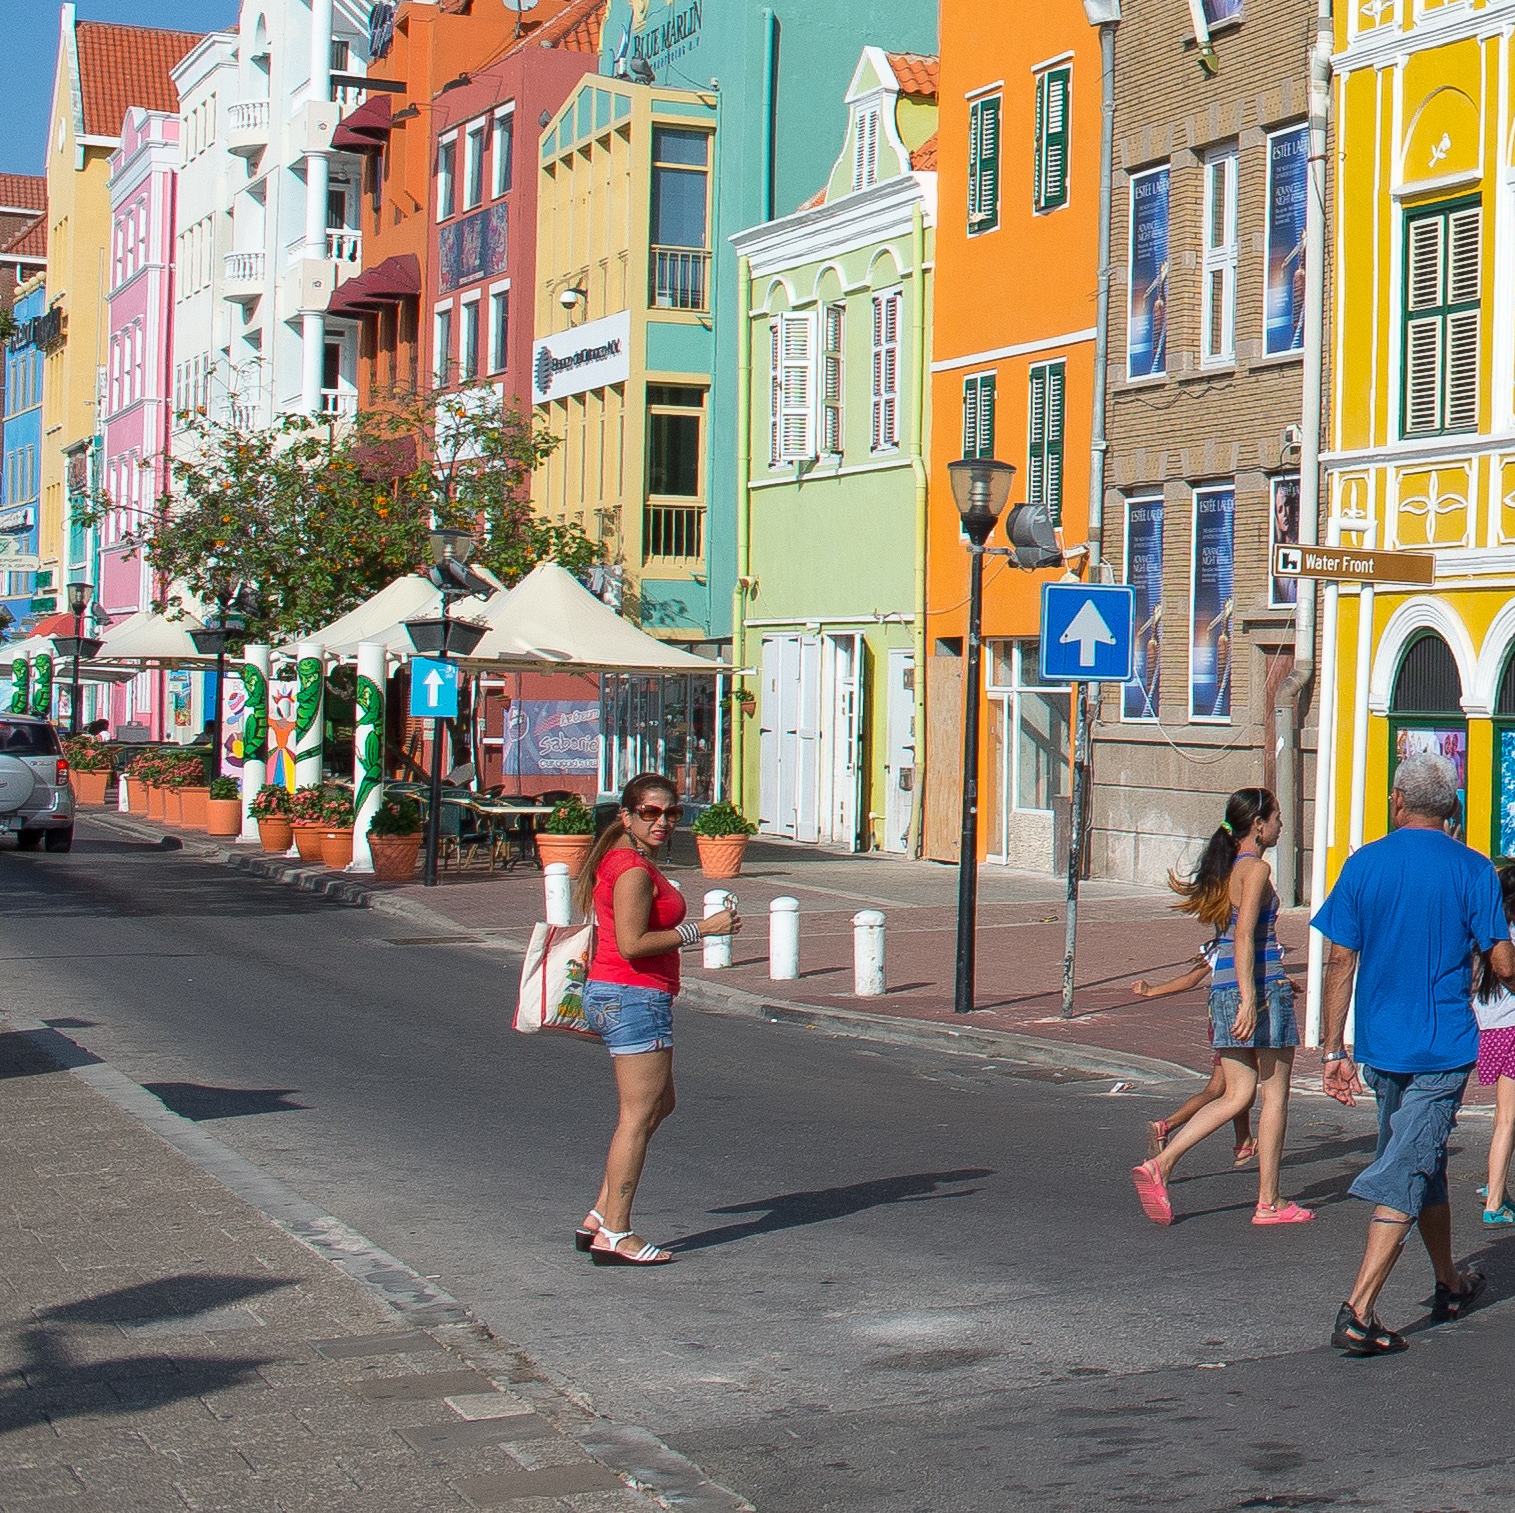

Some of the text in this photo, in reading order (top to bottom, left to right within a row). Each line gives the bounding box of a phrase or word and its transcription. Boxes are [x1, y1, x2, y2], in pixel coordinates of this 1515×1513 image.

[633, 28, 660, 61] BLUE
[1306, 553, 1375, 574] Water Front
